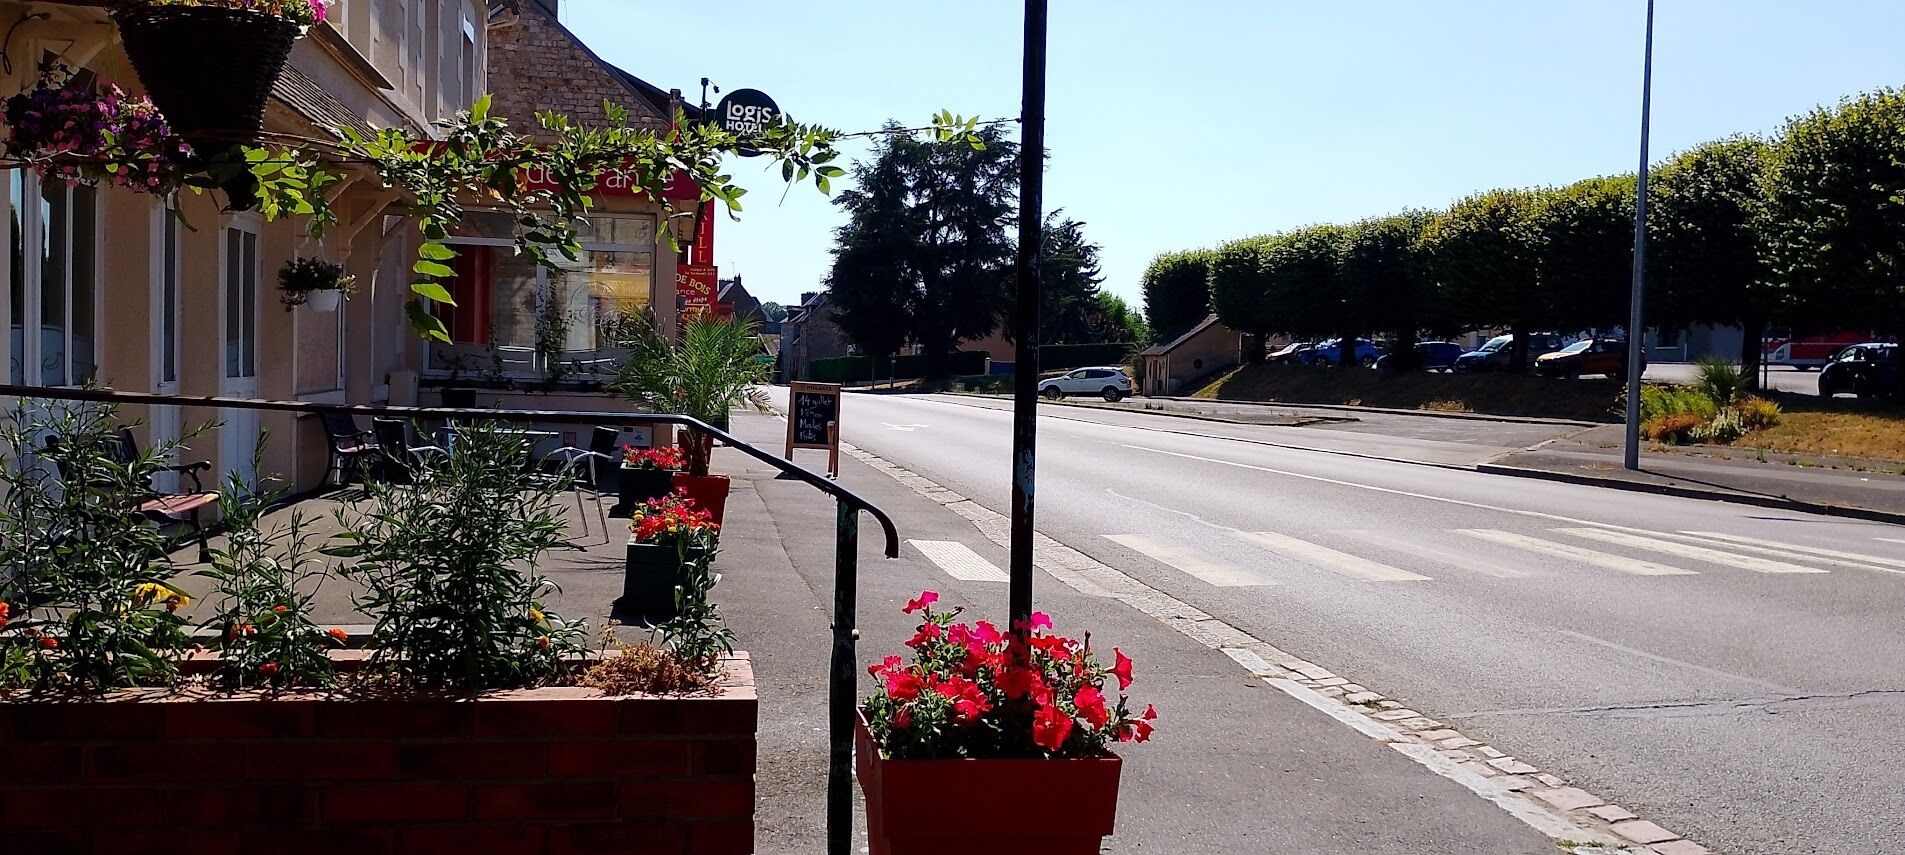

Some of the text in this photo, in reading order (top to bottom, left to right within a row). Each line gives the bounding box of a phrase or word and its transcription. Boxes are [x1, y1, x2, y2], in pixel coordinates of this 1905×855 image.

[726, 101, 772, 126] Logis
[726, 120, 763, 133] HOTEL
[689, 278, 711, 295] BOIS
[798, 394, 811, 406] 14
